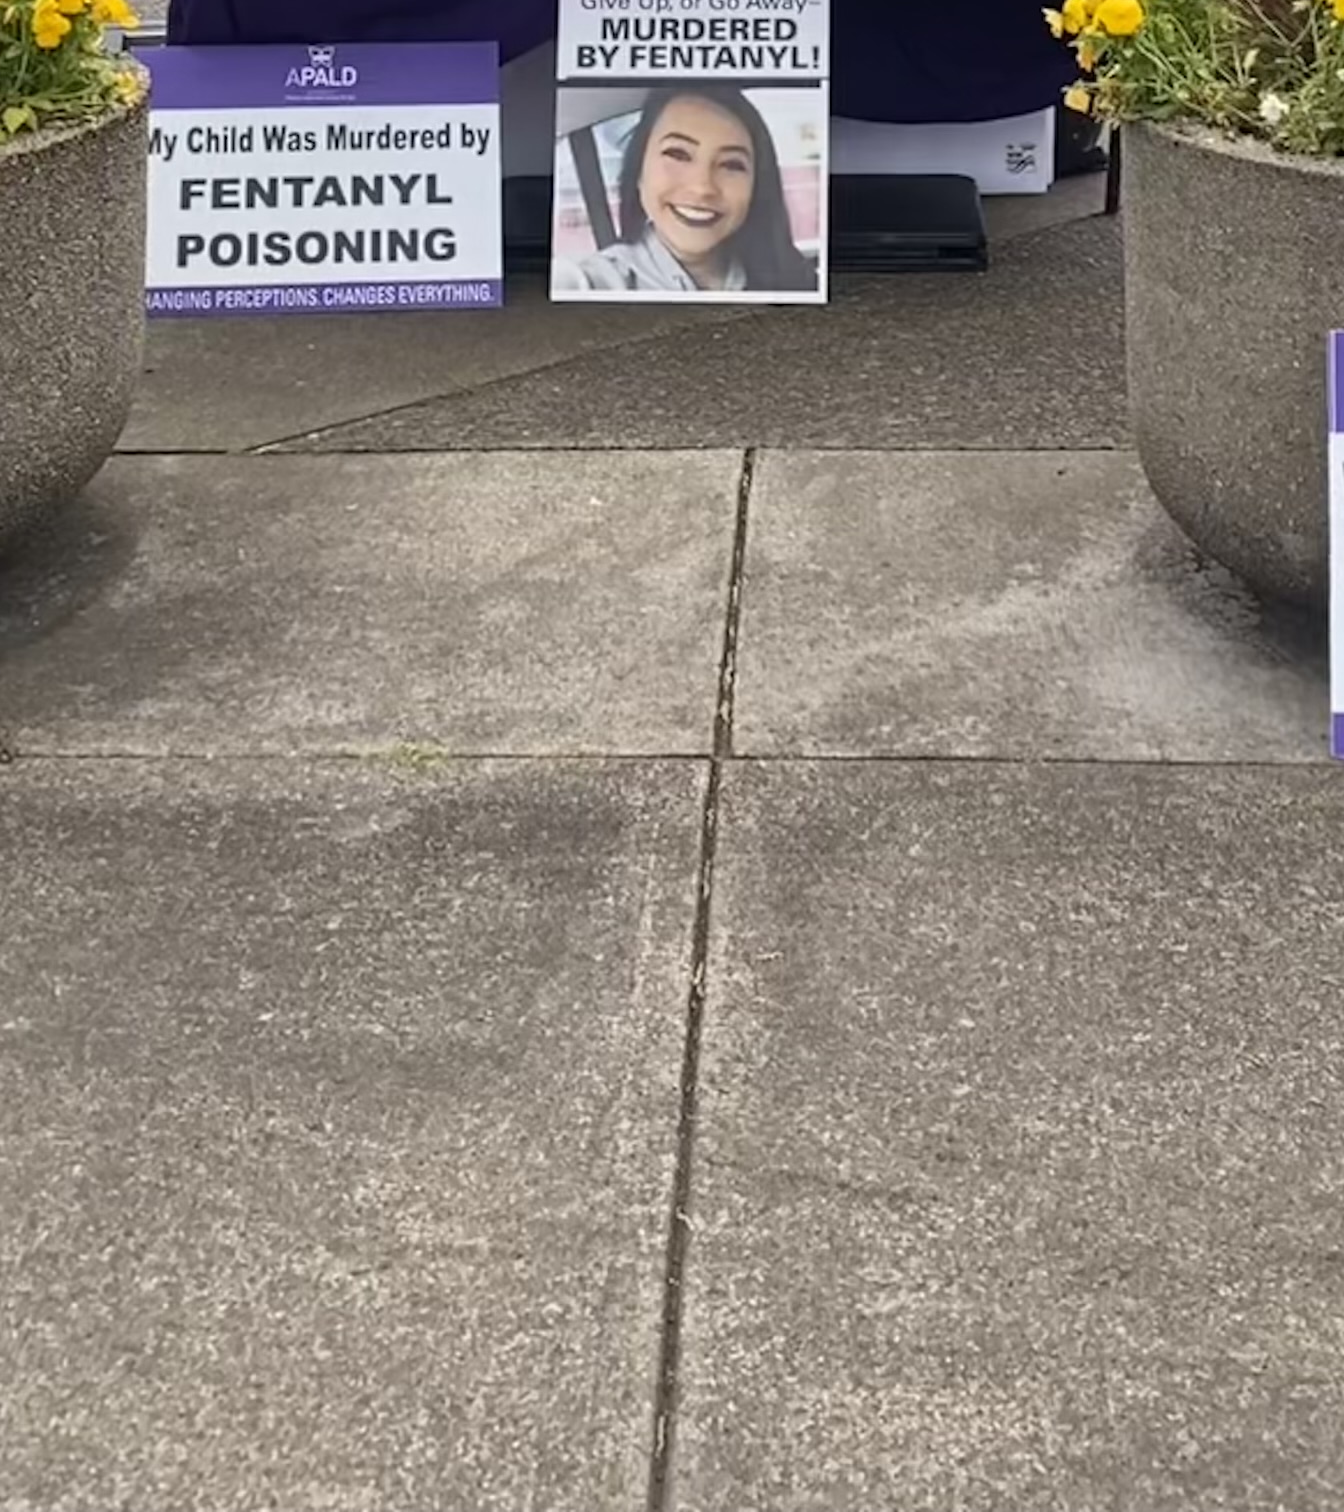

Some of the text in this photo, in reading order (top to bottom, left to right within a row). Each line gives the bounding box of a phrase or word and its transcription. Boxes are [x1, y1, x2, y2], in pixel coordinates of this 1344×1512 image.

[601, 18, 798, 41] MURDERED
[577, 45, 820, 69] BY FENTANYL!
[285, 66, 357, 87] APALD
[186, 126, 254, 154] Child
[263, 125, 316, 152] Was
[326, 123, 450, 151] Murdered
[461, 122, 490, 155] by
[179, 173, 453, 210] FENTANYL
[176, 228, 456, 268] POISONING
[215, 288, 321, 308] PERCEPTIONS.
[322, 285, 396, 306] CHANGES
[398, 283, 495, 304] EVERYTHING.
